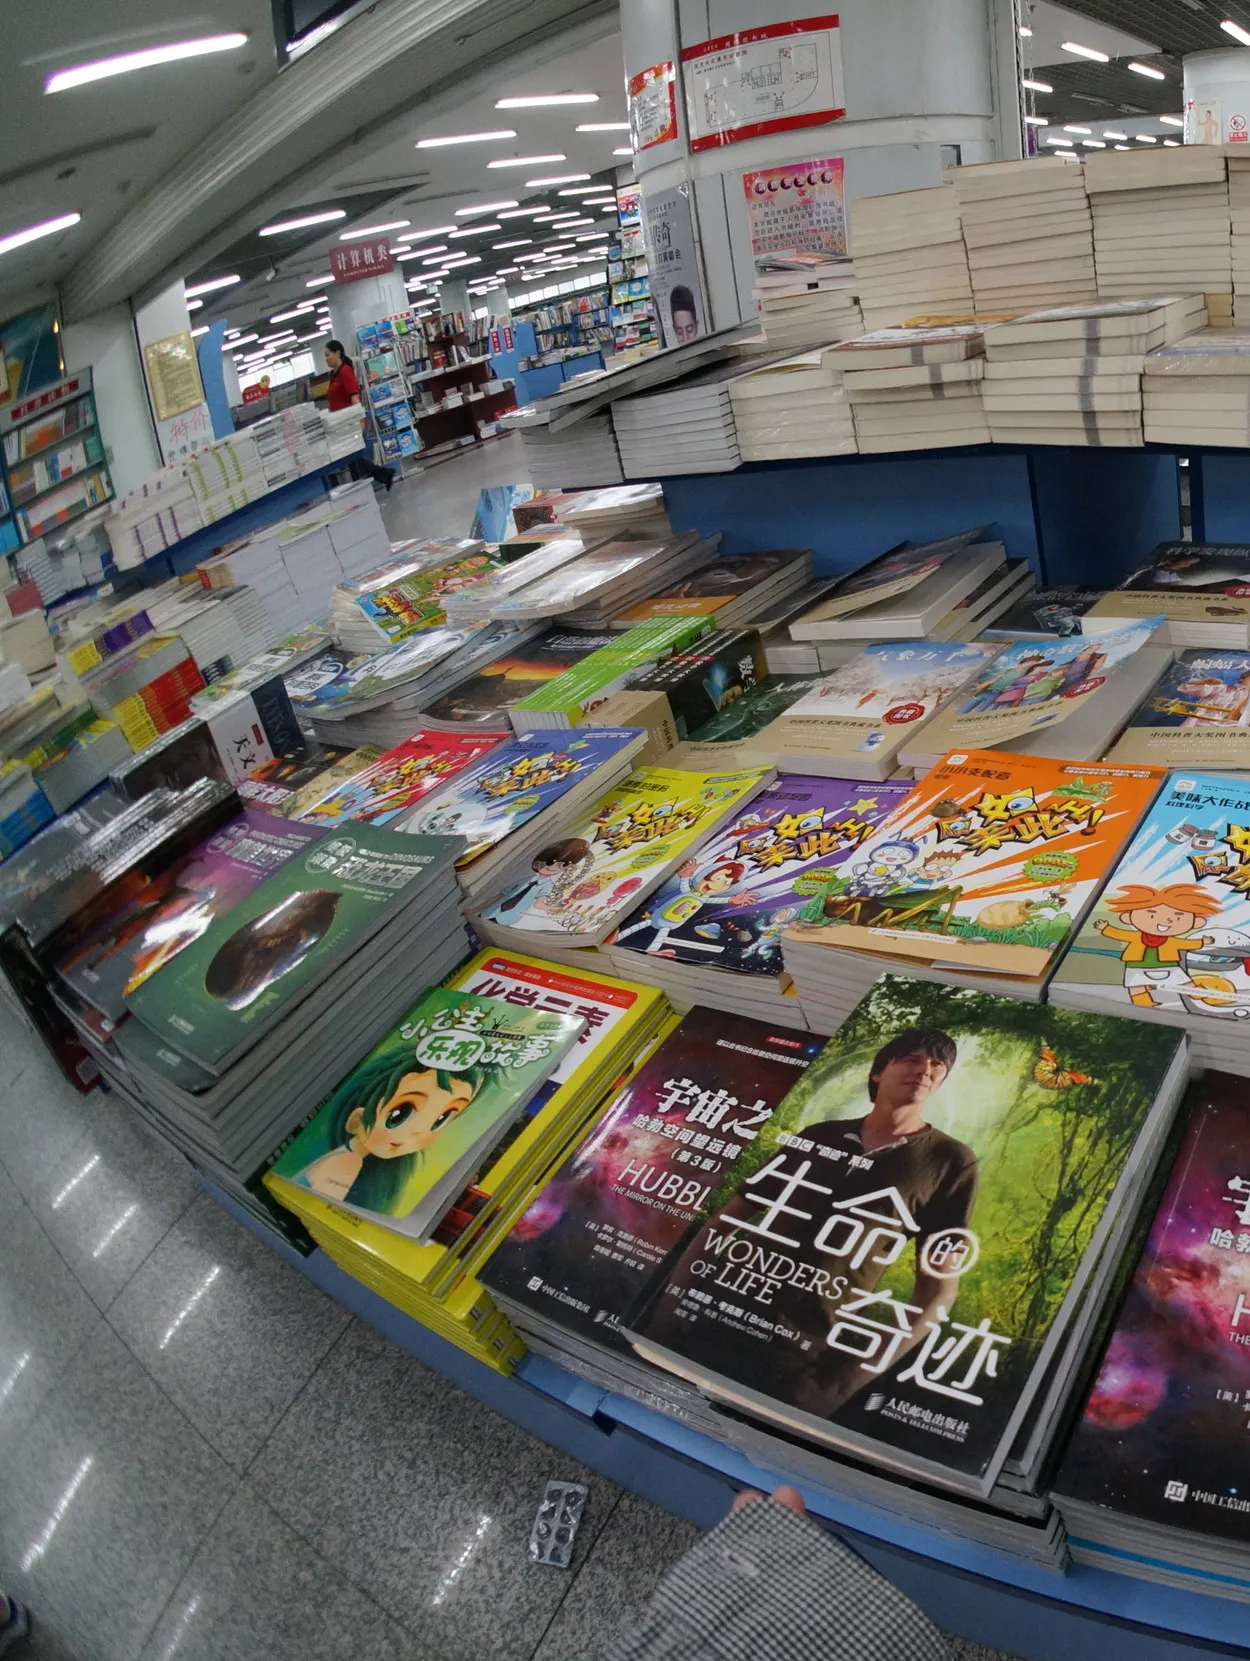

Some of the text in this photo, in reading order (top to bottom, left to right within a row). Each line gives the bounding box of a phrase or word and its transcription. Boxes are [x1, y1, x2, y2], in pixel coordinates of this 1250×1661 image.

[337, 244, 388, 271] 计算机类
[170, 408, 208, 444] 特价
[400, 1005, 486, 1040] 小公主
[419, 1035, 483, 1067] 乐观
[479, 1033, 555, 1069] 故事
[719, 1152, 971, 1271] 生命 的
[689, 1258, 784, 1306] OF LIFE
[703, 1227, 849, 1302] WONDERS
[825, 1286, 1013, 1406] 奇迹
[885, 1396, 971, 1435] 人民邮电出版社
